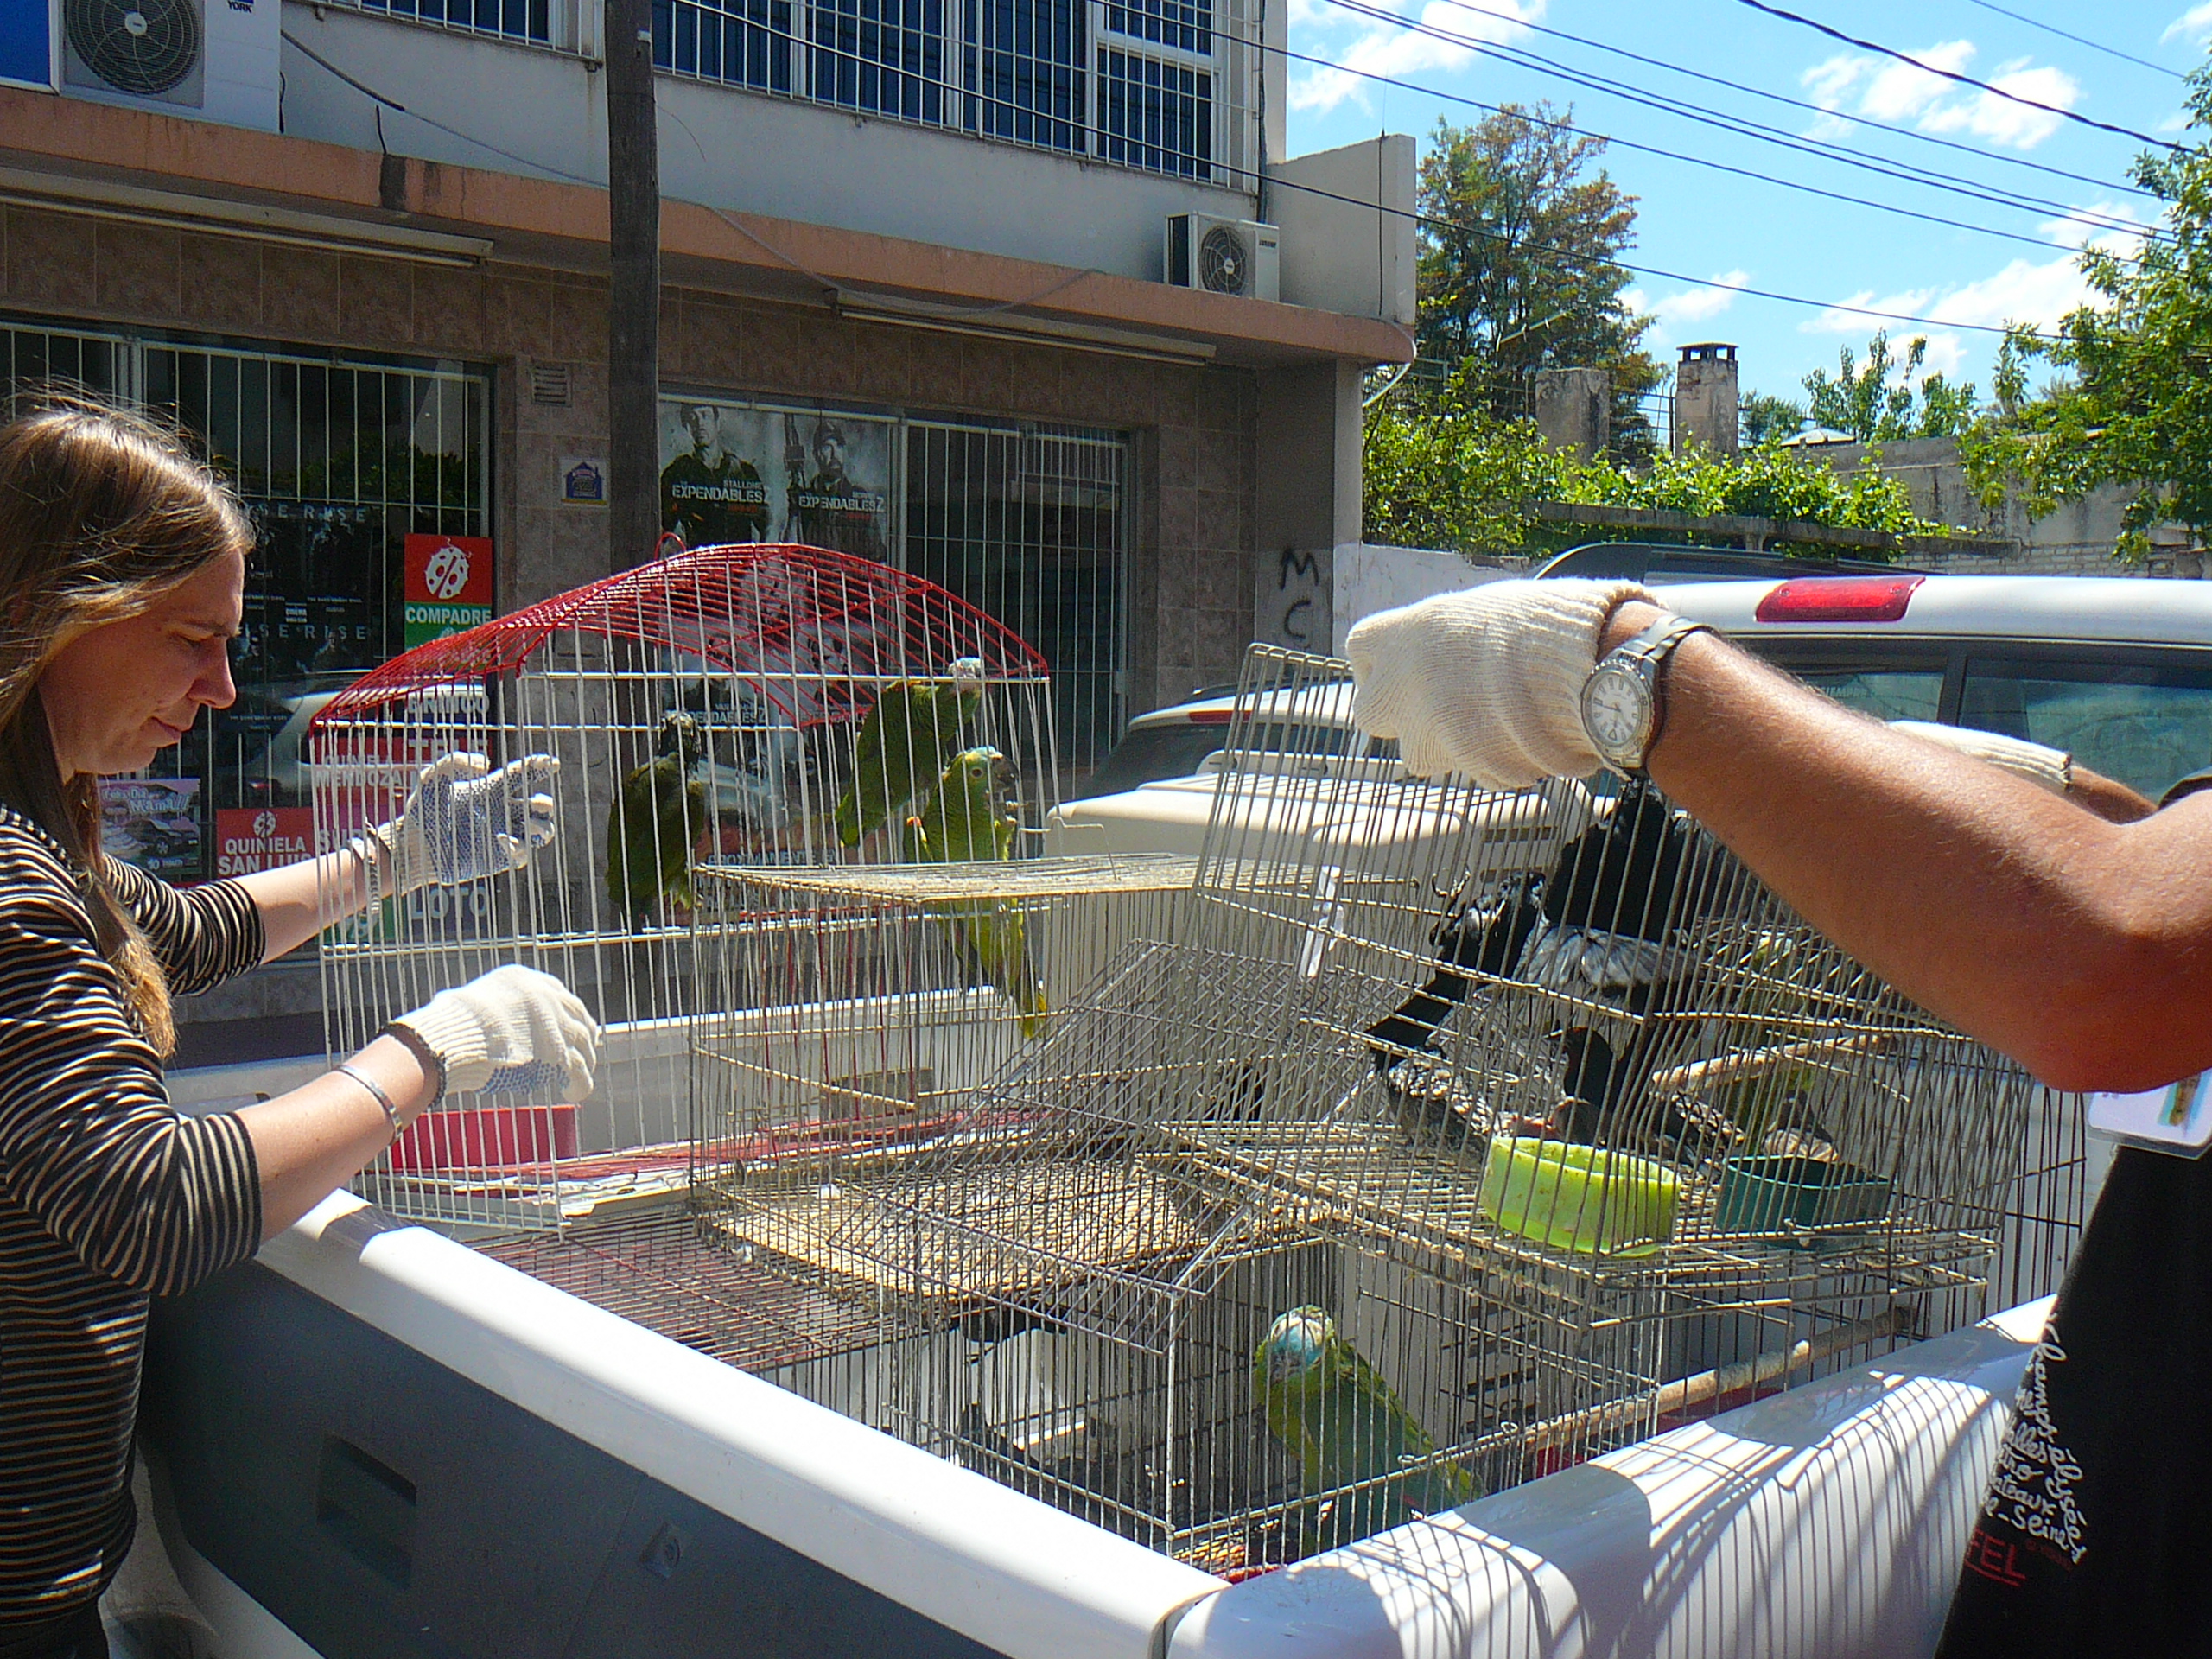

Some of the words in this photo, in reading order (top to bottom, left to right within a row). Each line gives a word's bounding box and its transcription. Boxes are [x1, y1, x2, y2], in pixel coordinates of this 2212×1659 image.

[227, 0, 252, 14] YORK
[671, 484, 763, 504] EXPENDABLES
[798, 495, 875, 512] EXPENDABLES
[405, 607, 492, 626] COMPADRE
[315, 770, 403, 788] MENDOZA
[225, 836, 306, 855] QUINIELA
[218, 855, 261, 875] SAN
